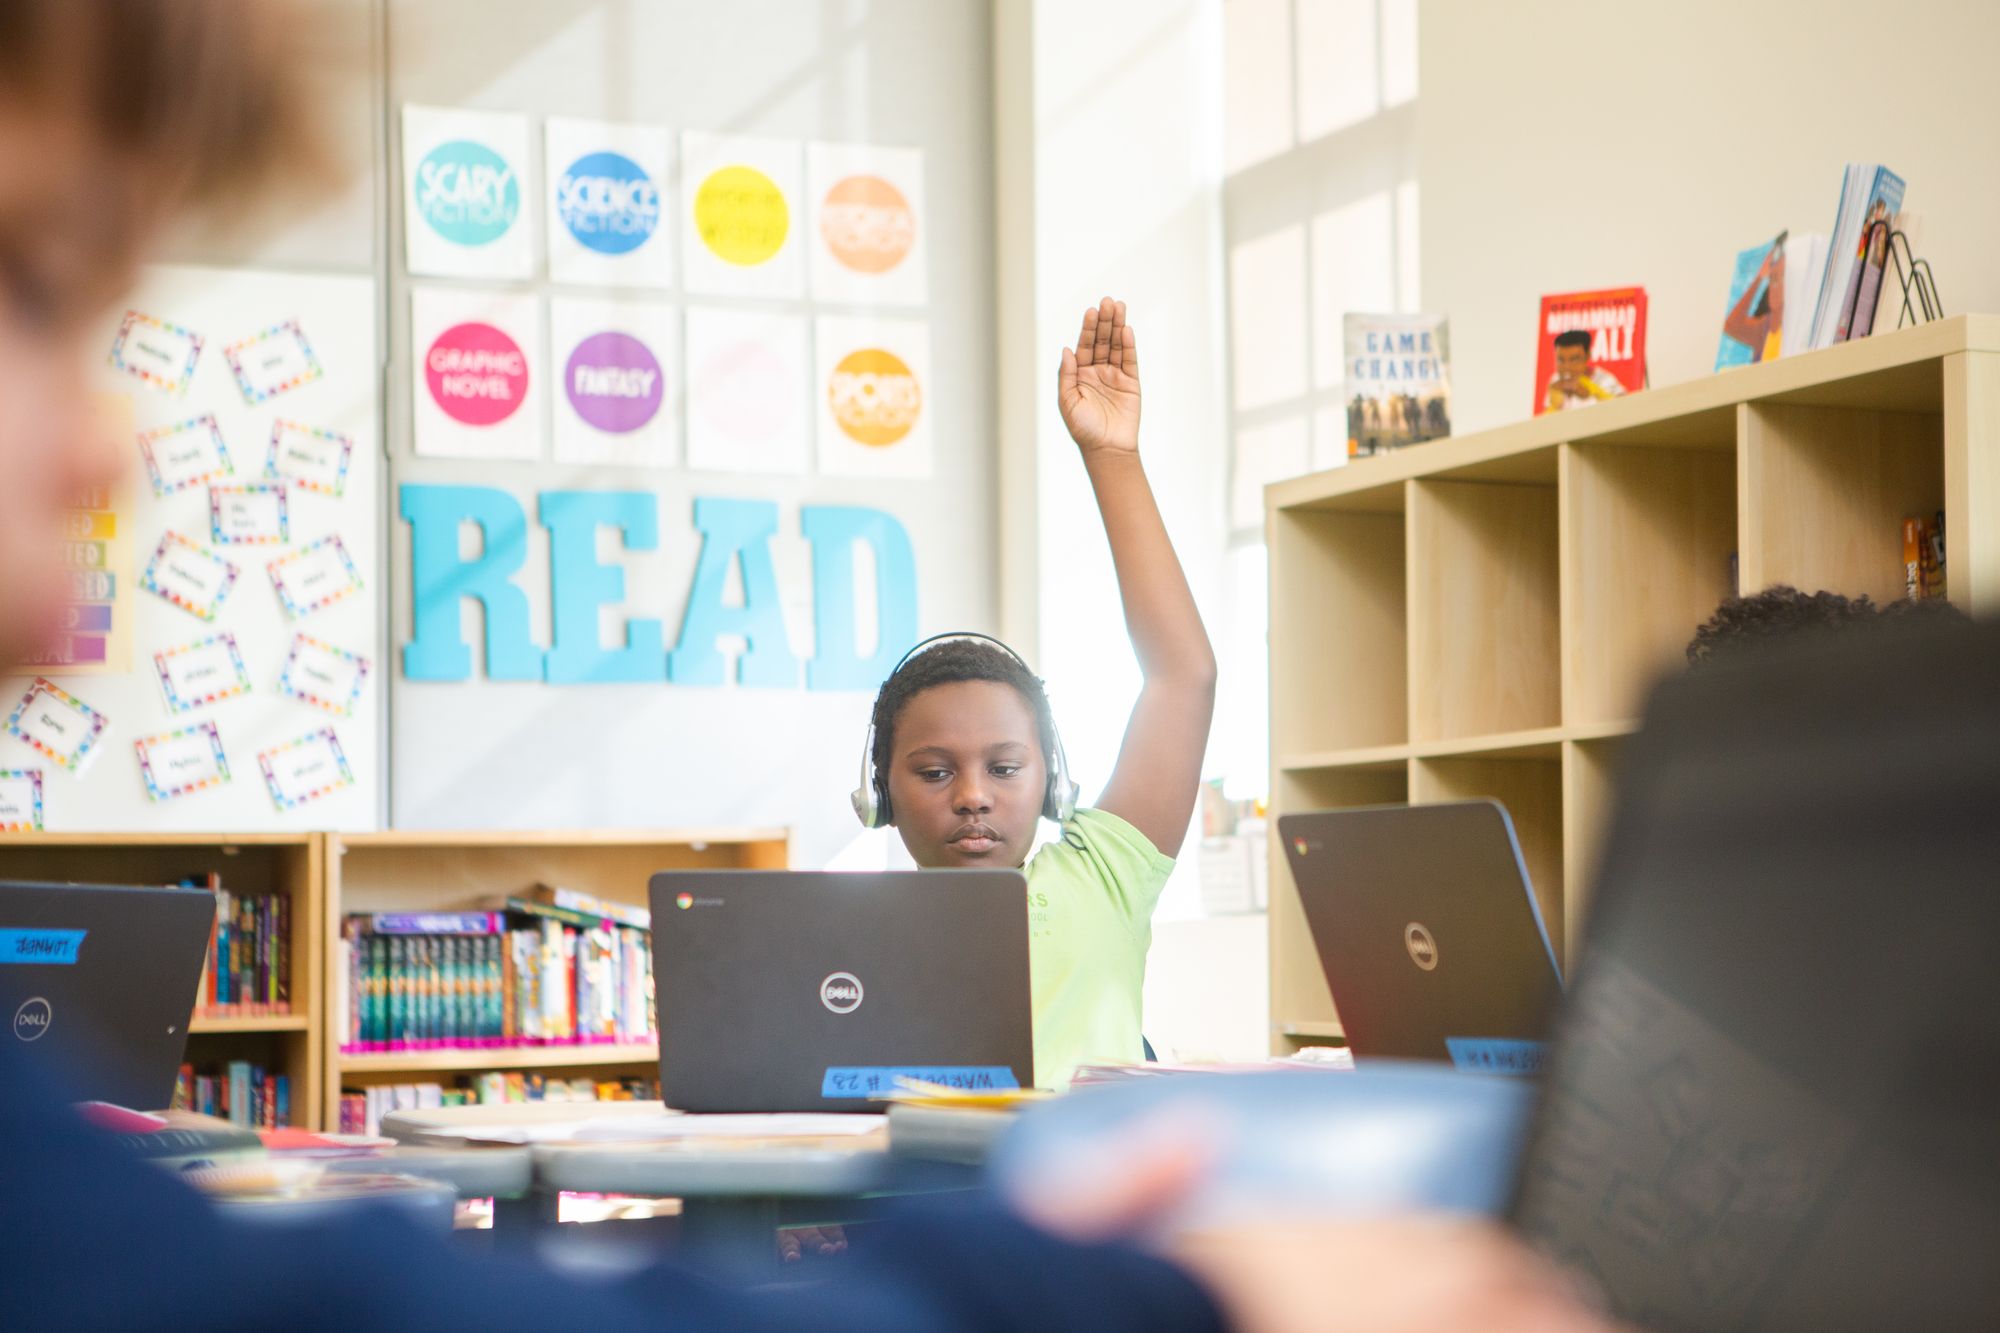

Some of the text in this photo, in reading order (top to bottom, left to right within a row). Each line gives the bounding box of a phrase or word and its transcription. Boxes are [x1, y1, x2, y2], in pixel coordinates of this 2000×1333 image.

[421, 161, 512, 204] SCARY
[559, 174, 658, 215] SCIENCE
[1366, 332, 1432, 353] GAME
[1591, 328, 1633, 361] ALI
[430, 347, 524, 376] GRAPHIC
[441, 373, 512, 400] NOVEL
[574, 364, 656, 398] FANTASY
[399, 484, 918, 691] READ
